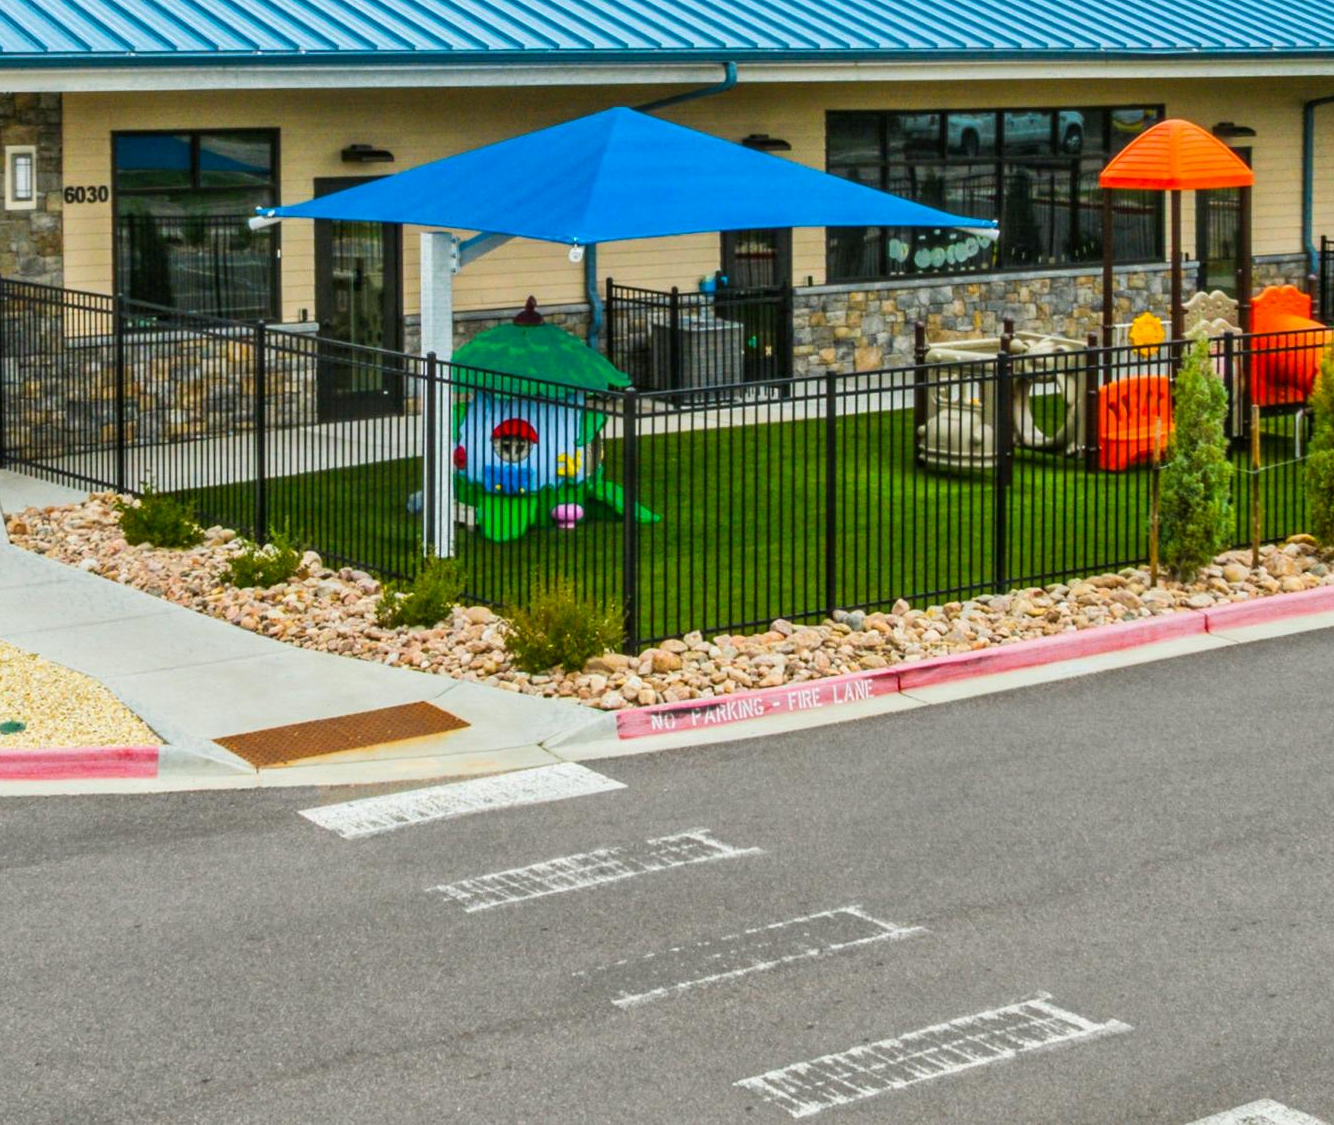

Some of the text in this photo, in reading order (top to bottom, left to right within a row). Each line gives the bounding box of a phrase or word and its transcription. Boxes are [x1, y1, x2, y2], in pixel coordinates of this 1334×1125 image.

[64, 185, 109, 204] 6030
[650, 711, 676, 730] NO
[690, 698, 765, 726] PARKING
[787, 687, 823, 711] FIRE
[832, 678, 875, 704] LANE
